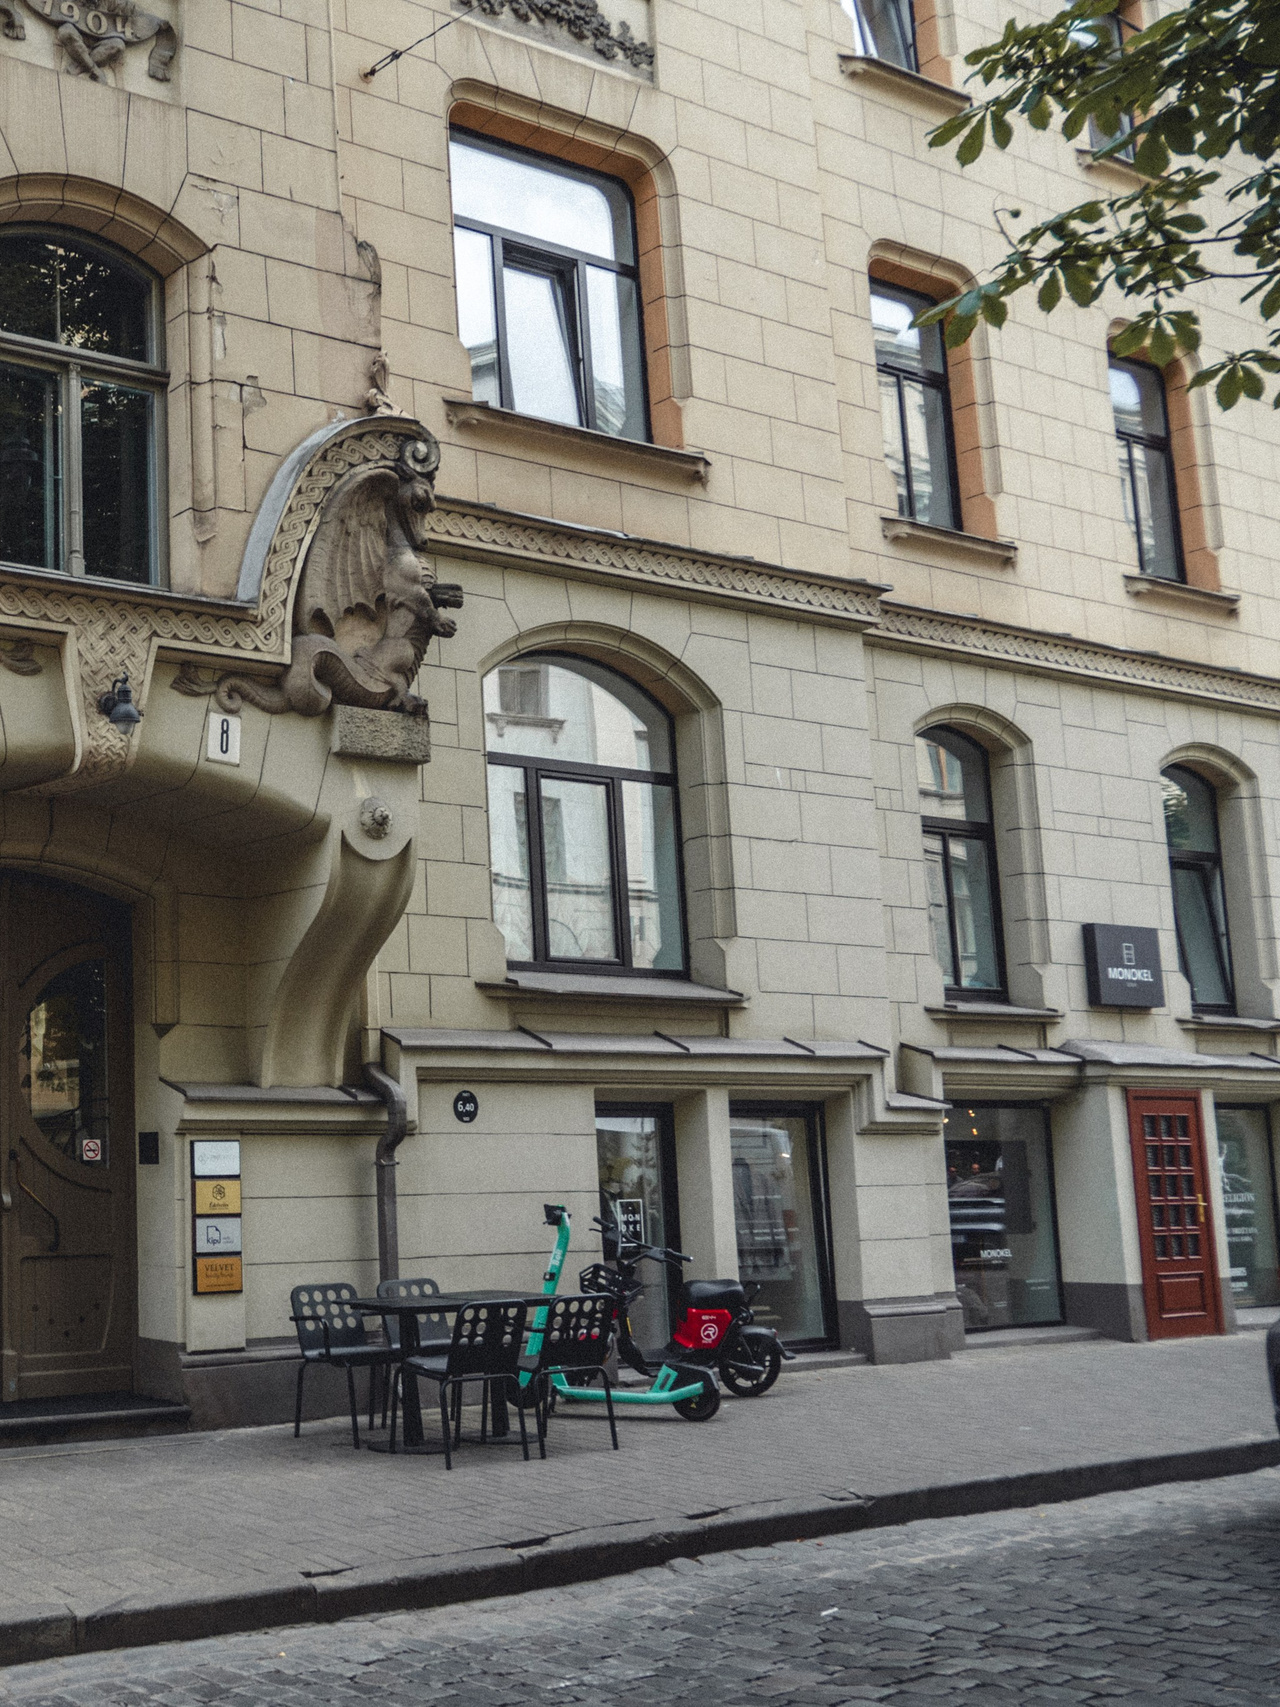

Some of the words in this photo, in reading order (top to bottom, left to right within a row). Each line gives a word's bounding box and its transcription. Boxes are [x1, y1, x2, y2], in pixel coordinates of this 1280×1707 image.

[220, 718, 230, 755] 8
[1107, 967, 1154, 982] MONOKEL
[457, 1101, 475, 1112] 6,40
[980, 1248, 1013, 1258] MONOKEL
